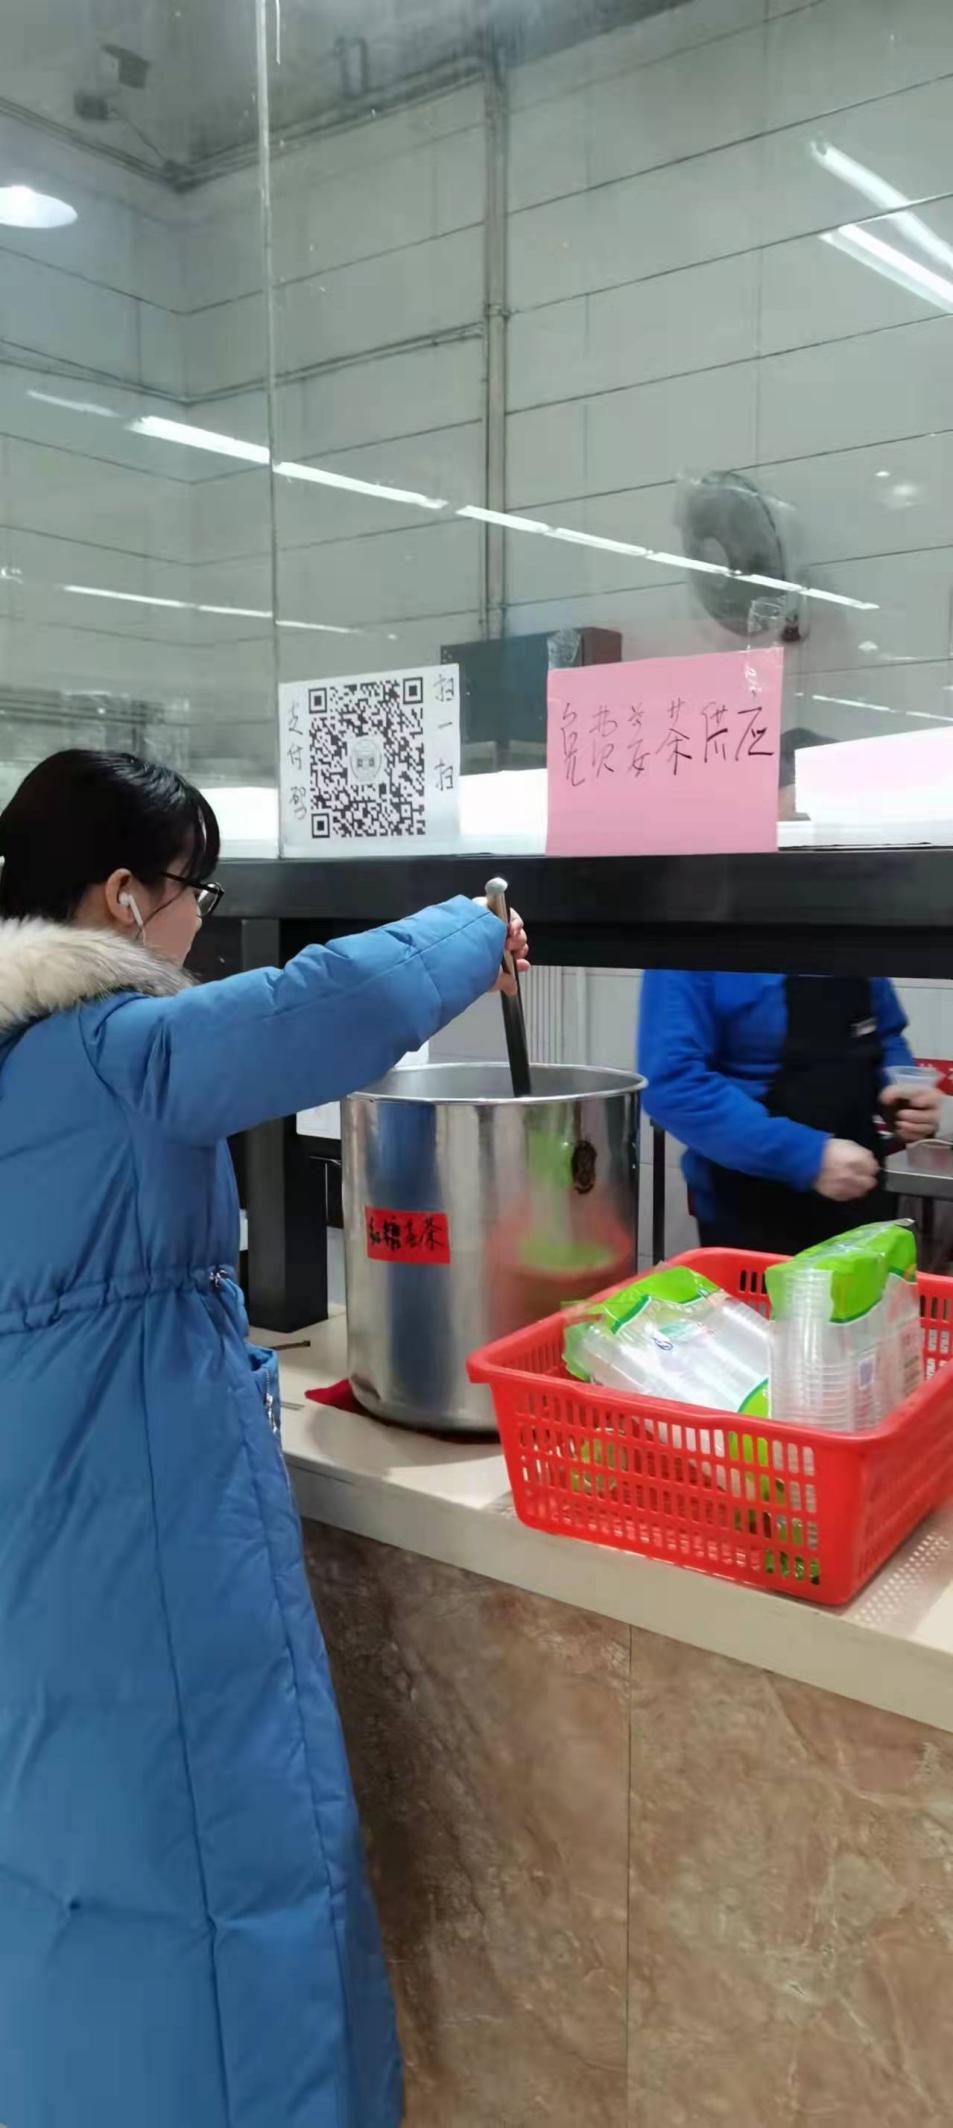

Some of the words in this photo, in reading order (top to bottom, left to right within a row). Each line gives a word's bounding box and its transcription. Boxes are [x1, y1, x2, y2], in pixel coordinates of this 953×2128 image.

[433, 673, 454, 792] 扫一扫
[560, 690, 774, 787] 免费姜茶供应
